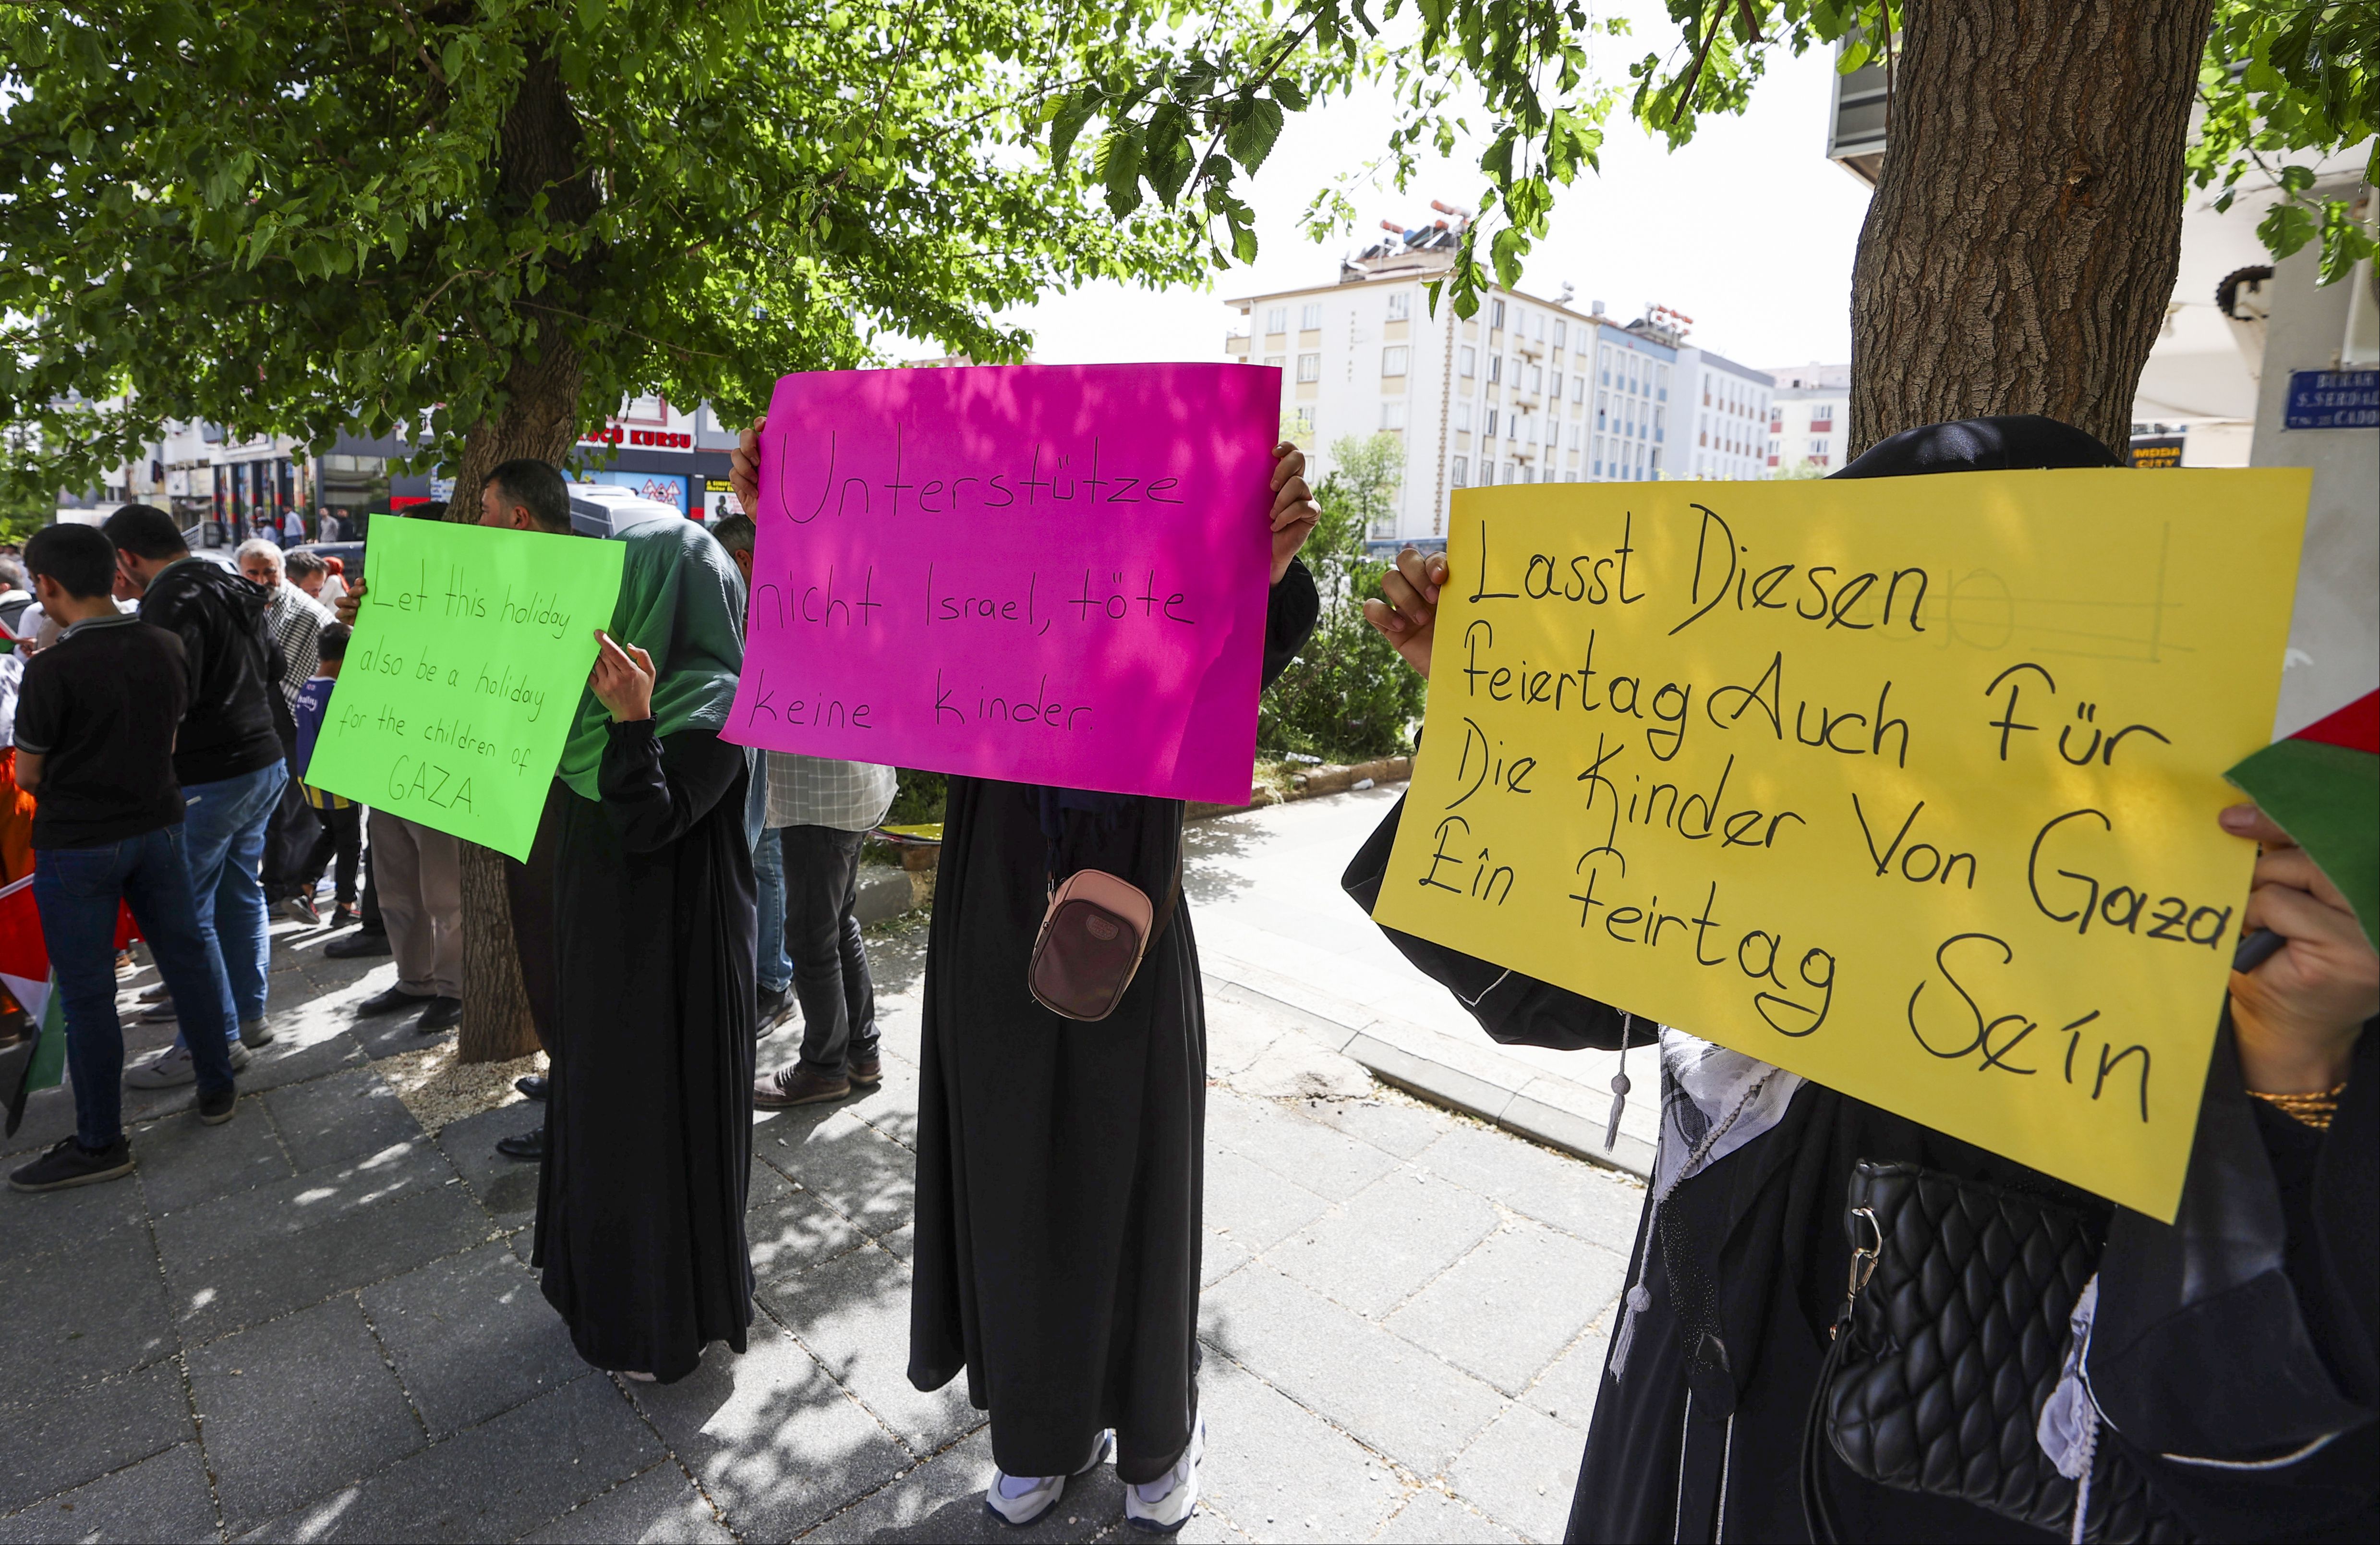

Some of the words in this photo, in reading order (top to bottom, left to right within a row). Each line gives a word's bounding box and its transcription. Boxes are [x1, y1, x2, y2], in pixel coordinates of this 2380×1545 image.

[630, 430, 690, 448] KURSU
[781, 422, 1184, 523] Unterstütze
[2133, 447, 2180, 458] MODA
[373, 552, 428, 611] Let
[445, 564, 485, 618] this
[500, 584, 570, 639] holiday
[756, 562, 882, 631] nicht
[927, 562, 1050, 636] Israel,
[1068, 569, 1195, 624] töte
[1469, 511, 1645, 605] Lasst
[1668, 503, 1928, 636] Diesen
[360, 635, 402, 675] also
[416, 645, 437, 681] be
[448, 669, 459, 687] a
[475, 662, 545, 722] holiday
[1707, 651, 1909, 768] Auch
[338, 705, 366, 737] for
[377, 704, 405, 736] the
[424, 718, 495, 756] children
[512, 748, 531, 776] of
[1446, 717, 1533, 810] Die
[1577, 732, 1806, 856] Kinder
[1852, 793, 1976, 889] Von
[2028, 809, 2234, 950] Gaza
[1908, 933, 2150, 1123] Sein
